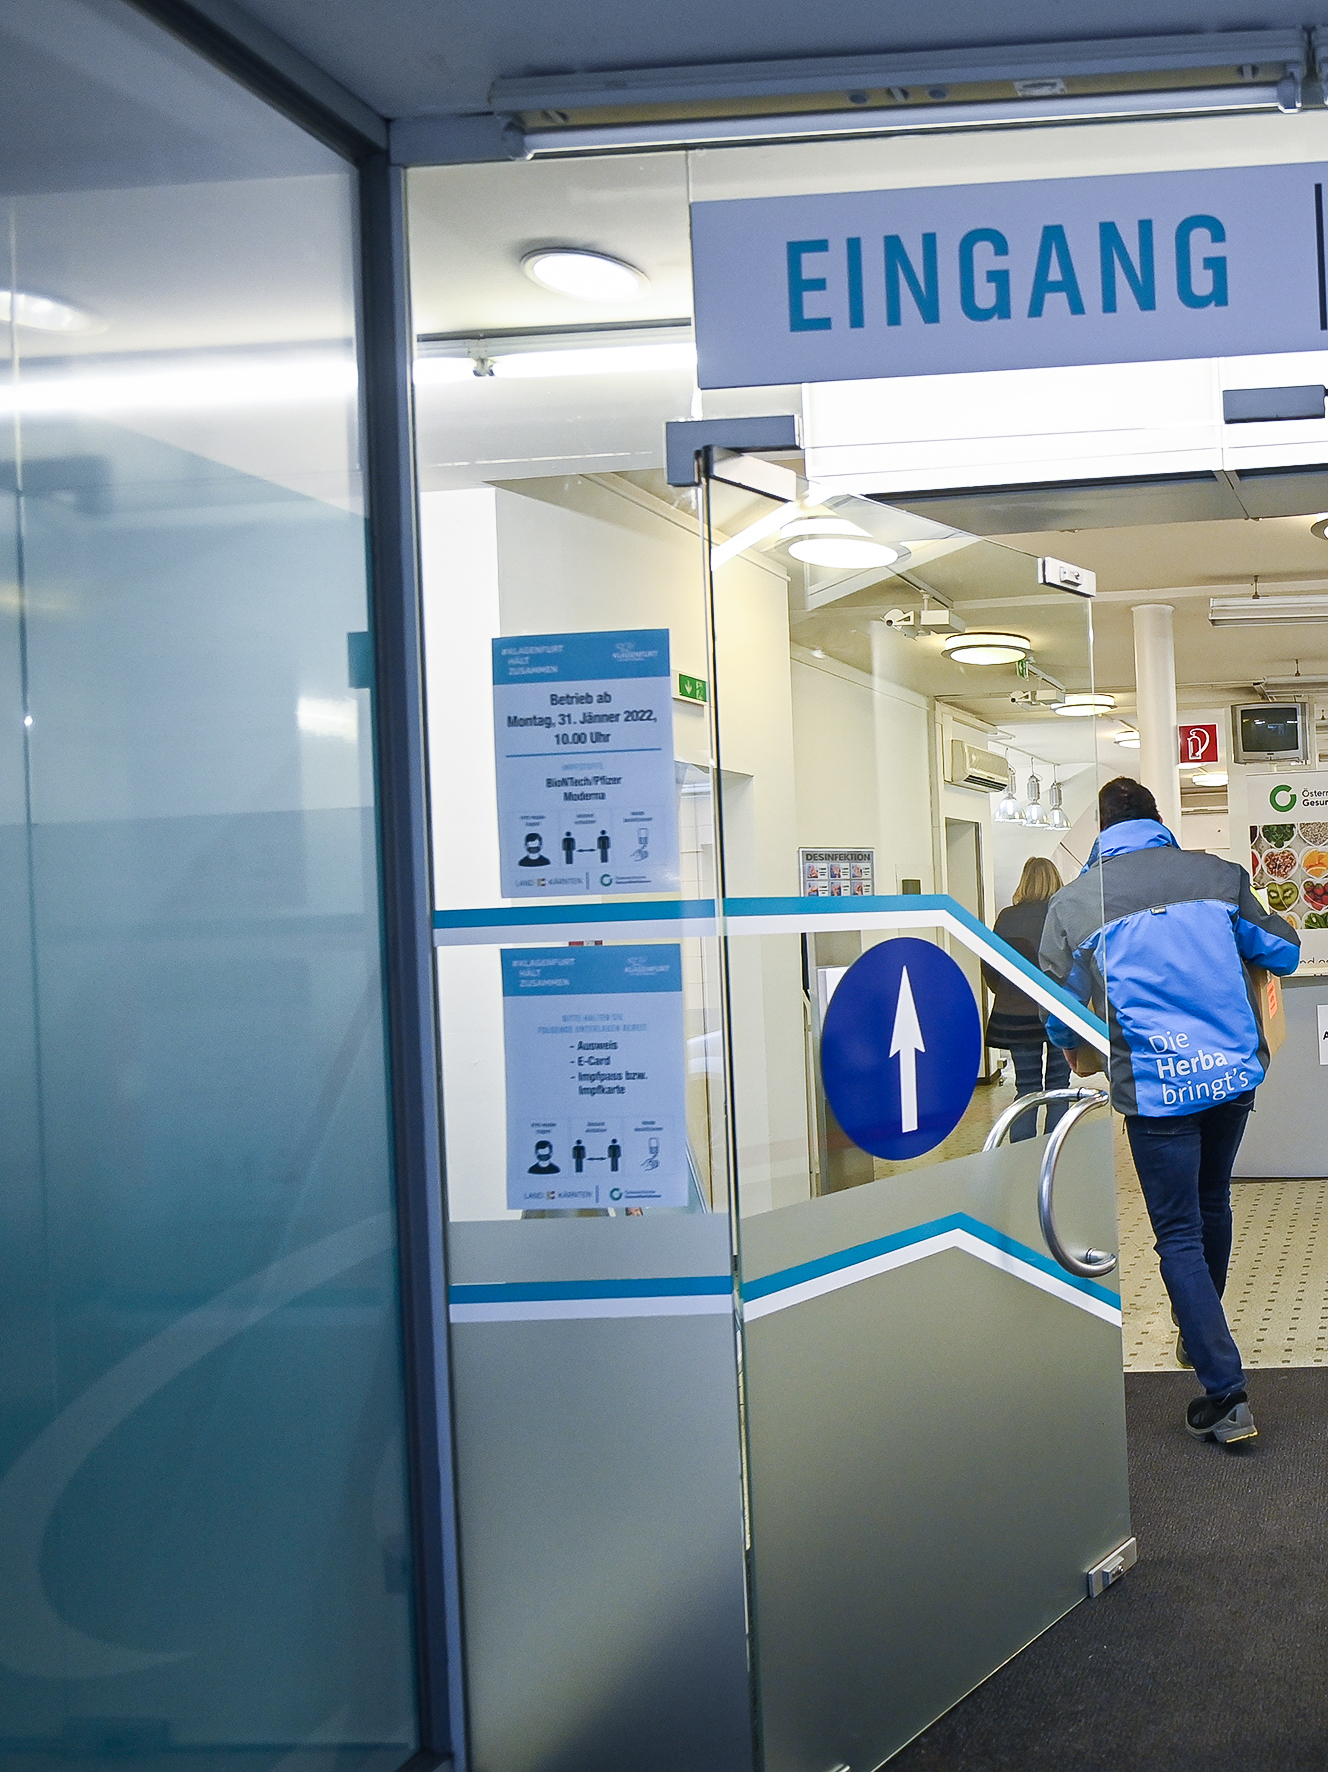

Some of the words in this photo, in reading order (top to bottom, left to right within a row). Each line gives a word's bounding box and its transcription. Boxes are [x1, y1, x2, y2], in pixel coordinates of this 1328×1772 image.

[787, 214, 1229, 332] EINGANG
[550, 692, 594, 706] Betrieb
[596, 691, 612, 704] ab
[507, 715, 556, 729] Montag,
[557, 713, 577, 725] 31.
[579, 711, 621, 724] Jänner
[623, 709, 657, 723] 2022,
[554, 732, 587, 745] 10.00
[590, 731, 611, 743] Uhr
[545, 775, 622, 788] BioNTech/Pfizer
[563, 792, 606, 801] Moderna
[805, 853, 871, 861] DESINFEKTION
[511, 958, 576, 967] #KLAGENFURT
[519, 978, 570, 988] ZUSAMMEN
[577, 1040, 618, 1051] Ausweis
[1148, 1031, 1190, 1053] Die
[577, 1055, 611, 1066] E-Card
[1156, 1050, 1228, 1079] Herba
[578, 1071, 623, 1083] Impfpass
[625, 1070, 648, 1080] bzw.
[578, 1085, 626, 1097] Impfkarte
[1162, 1068, 1249, 1105] bringt's
